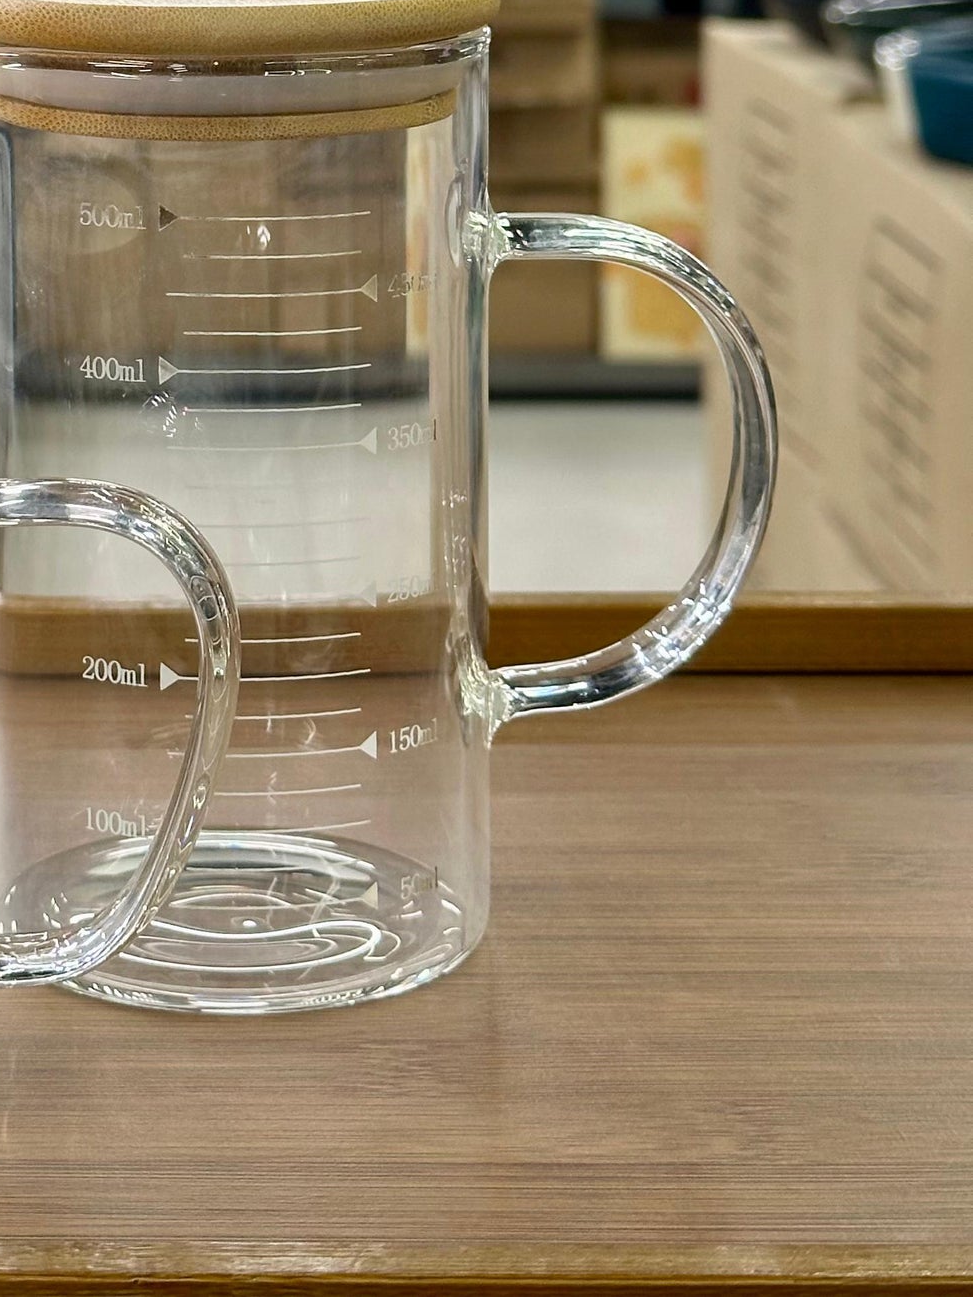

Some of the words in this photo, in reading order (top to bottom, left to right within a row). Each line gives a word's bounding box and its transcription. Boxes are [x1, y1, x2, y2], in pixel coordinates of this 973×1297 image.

[79, 355, 146, 382] 400ml
[388, 418, 437, 451] 350ml
[82, 655, 148, 687] 200ml
[389, 718, 438, 754] 150ml
[85, 807, 146, 838] 100ml
